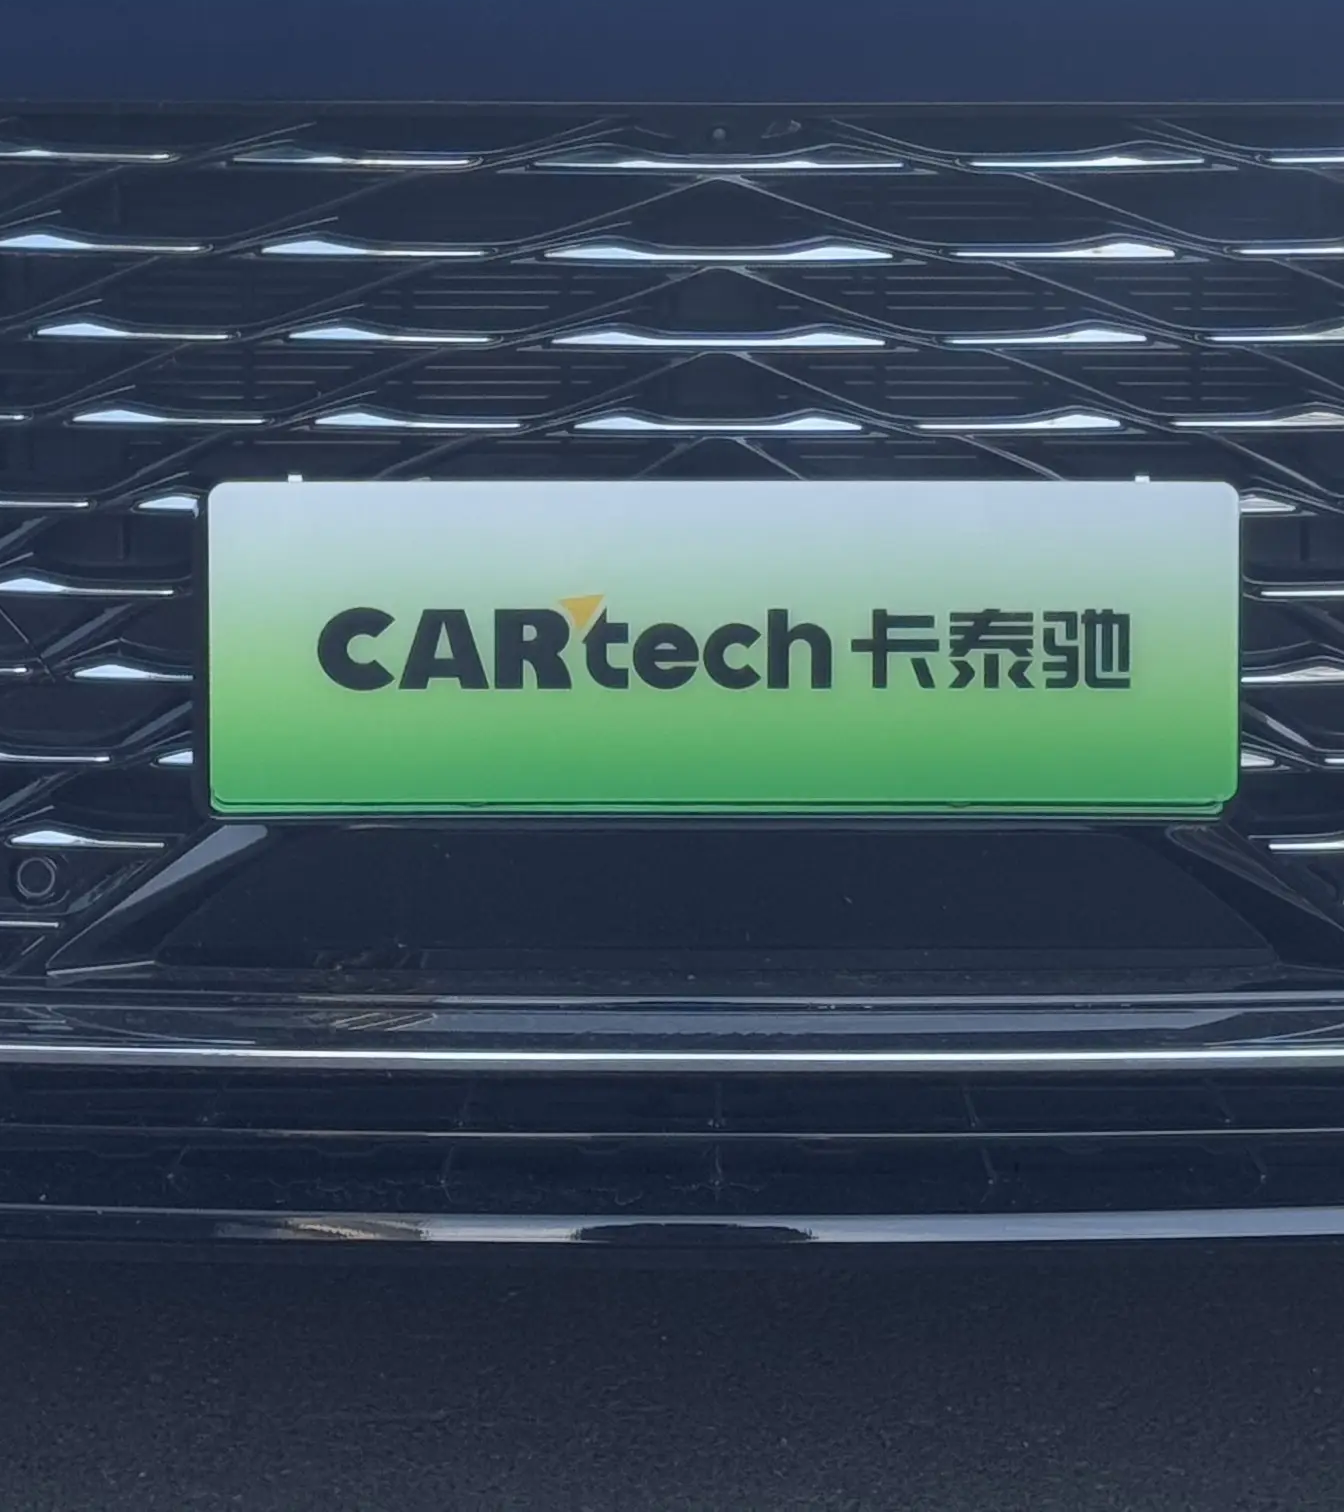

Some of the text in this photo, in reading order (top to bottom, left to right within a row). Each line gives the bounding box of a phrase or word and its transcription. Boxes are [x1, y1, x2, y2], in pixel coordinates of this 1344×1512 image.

[316, 604, 1131, 692] CARtech 卡泰驰
